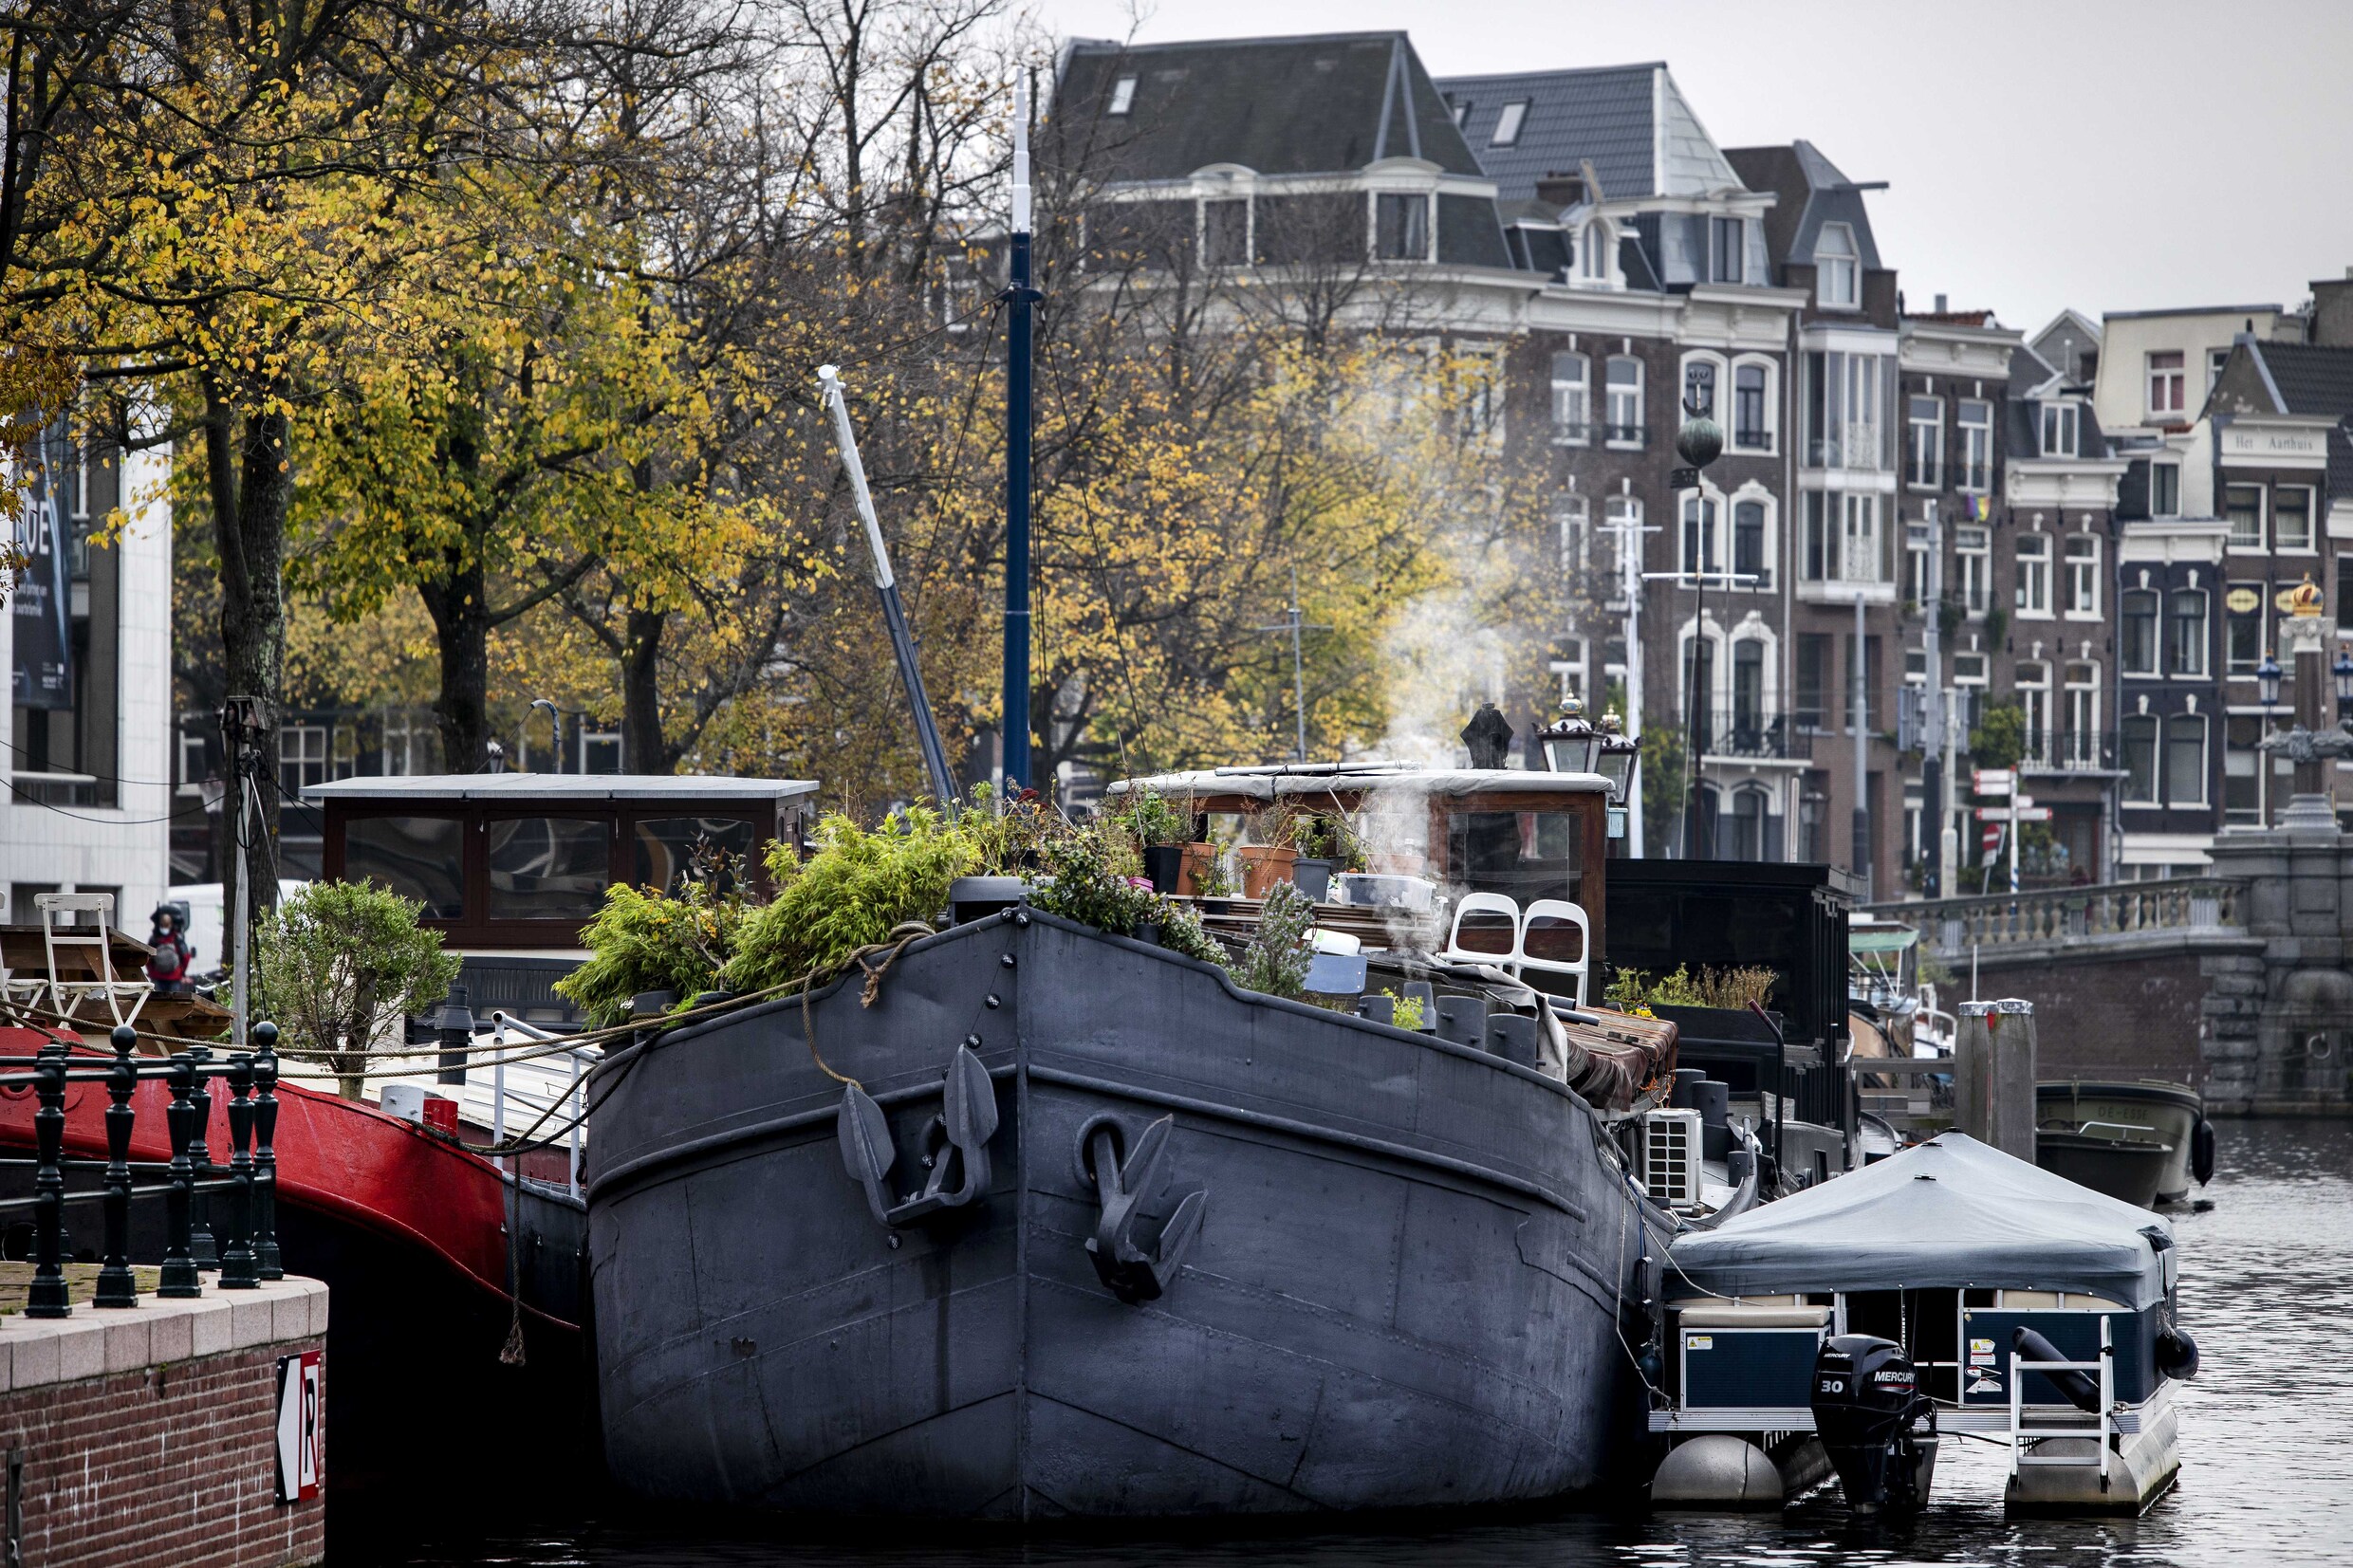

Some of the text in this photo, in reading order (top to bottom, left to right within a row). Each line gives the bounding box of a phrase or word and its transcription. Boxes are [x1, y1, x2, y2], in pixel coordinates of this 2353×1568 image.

[2236, 435, 2253, 450] Het
[1874, 1371, 1915, 1383] MERCURY
[1821, 1380, 1843, 1393] 30
